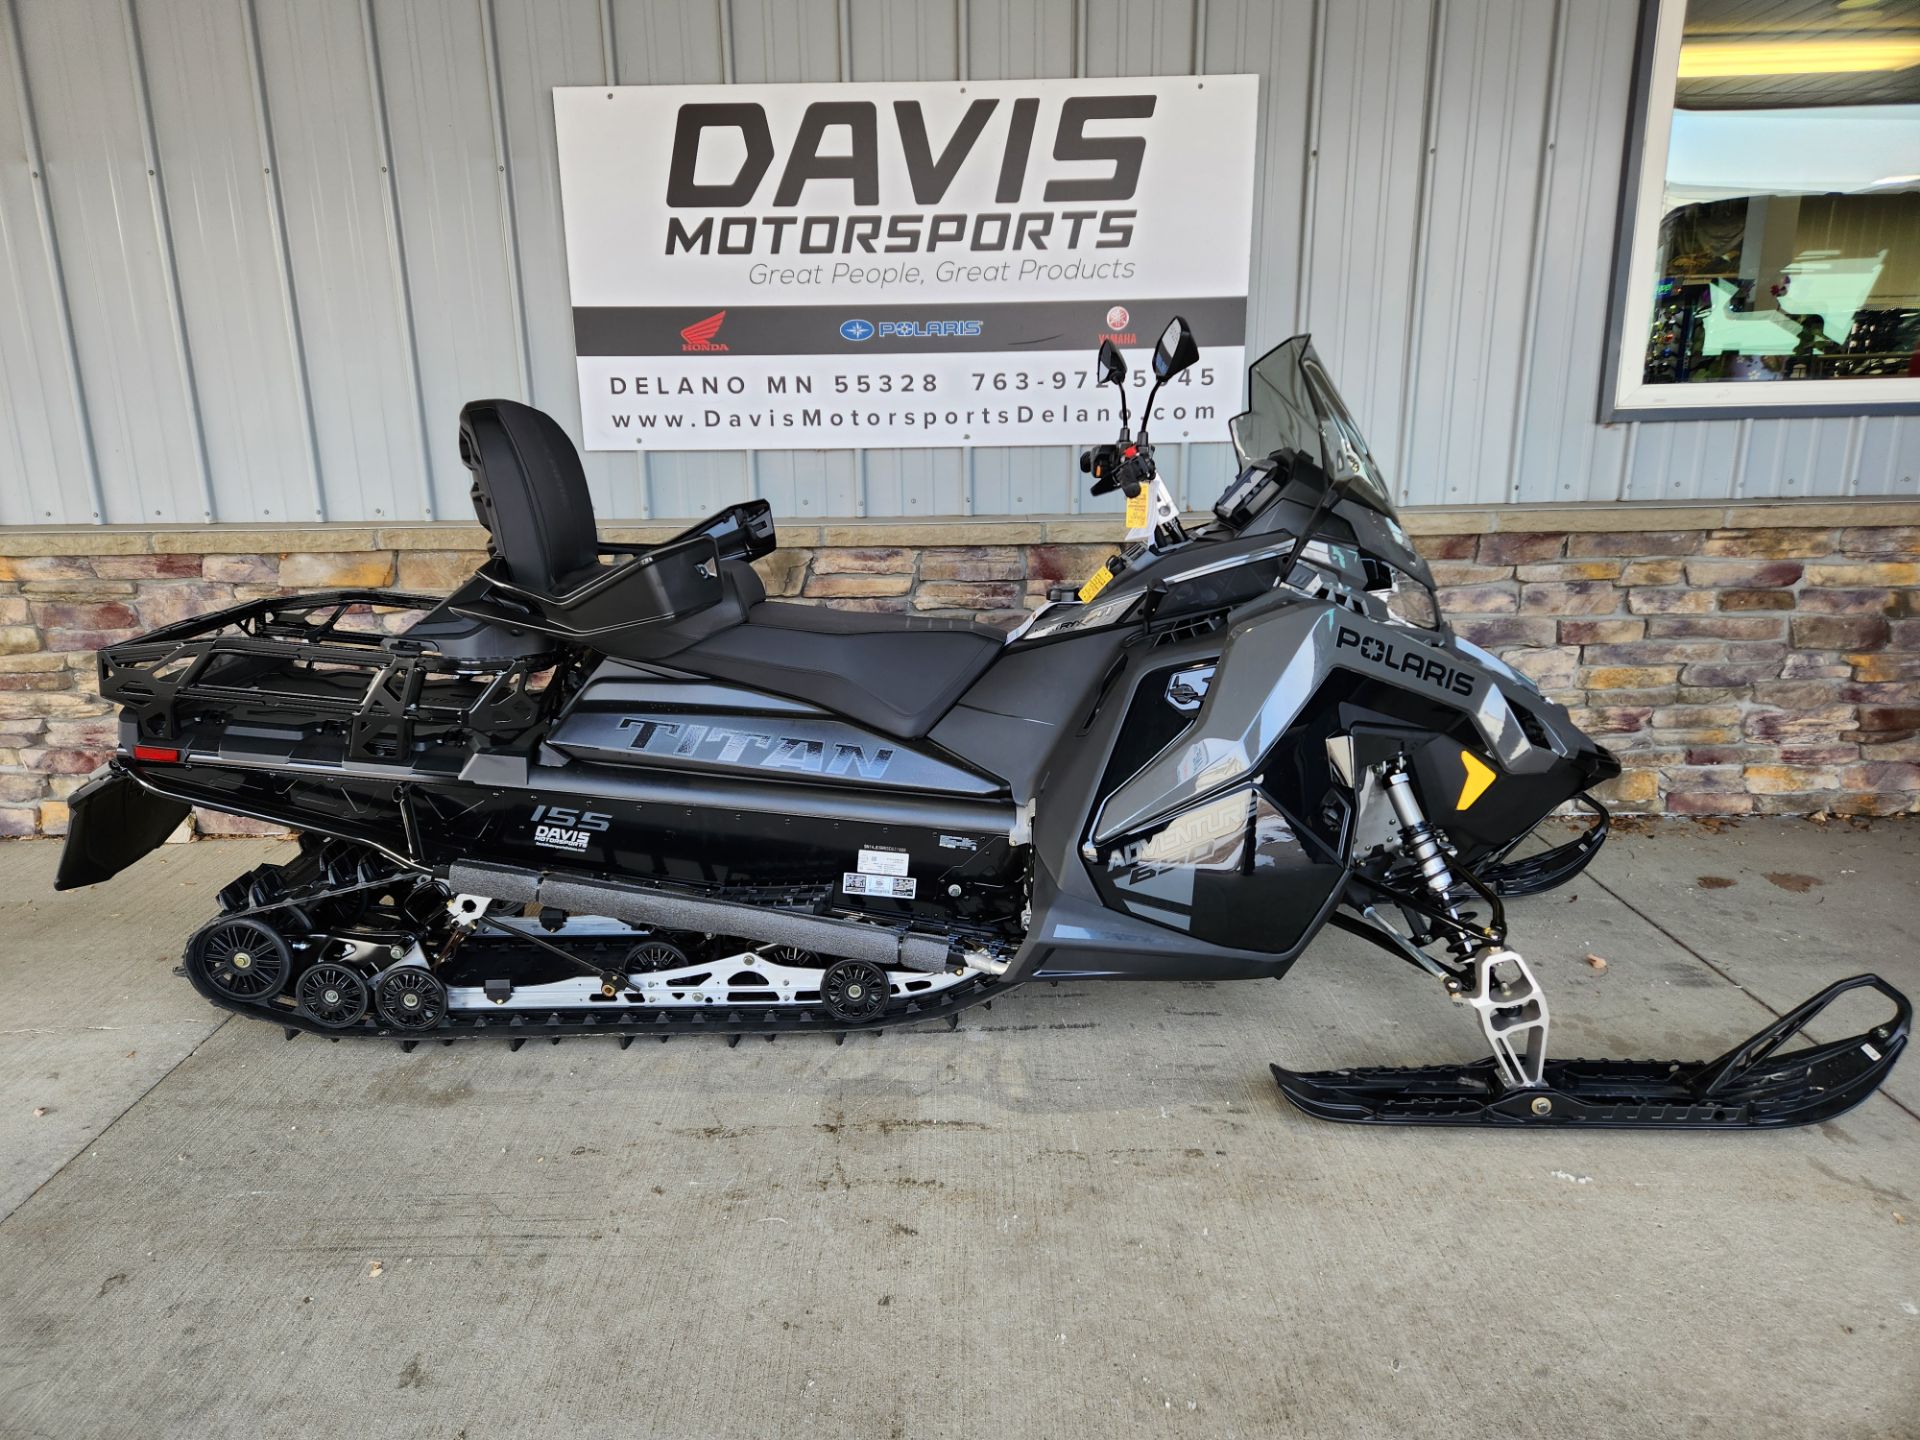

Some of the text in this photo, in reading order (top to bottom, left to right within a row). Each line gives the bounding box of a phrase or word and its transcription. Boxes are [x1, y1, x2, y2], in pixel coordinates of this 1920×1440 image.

[665, 94, 1156, 208] DAVIS
[665, 209, 1137, 256] MOTORSPORTS
[749, 257, 1136, 289] Great People, Great Products
[878, 320, 982, 337] POLARIS
[681, 343, 729, 352] HONDA
[609, 375, 744, 396] DELANO
[767, 375, 812, 395] MN
[835, 372, 937, 394] 55328
[611, 402, 1216, 431] www.DavisMotorsportsDelano.com
[1336, 625, 1476, 697] POLARIS
[616, 716, 896, 780] TITAN
[530, 804, 614, 832] 155
[534, 835, 588, 848] MOTORSPORTS
[535, 825, 591, 844] DAVIS
